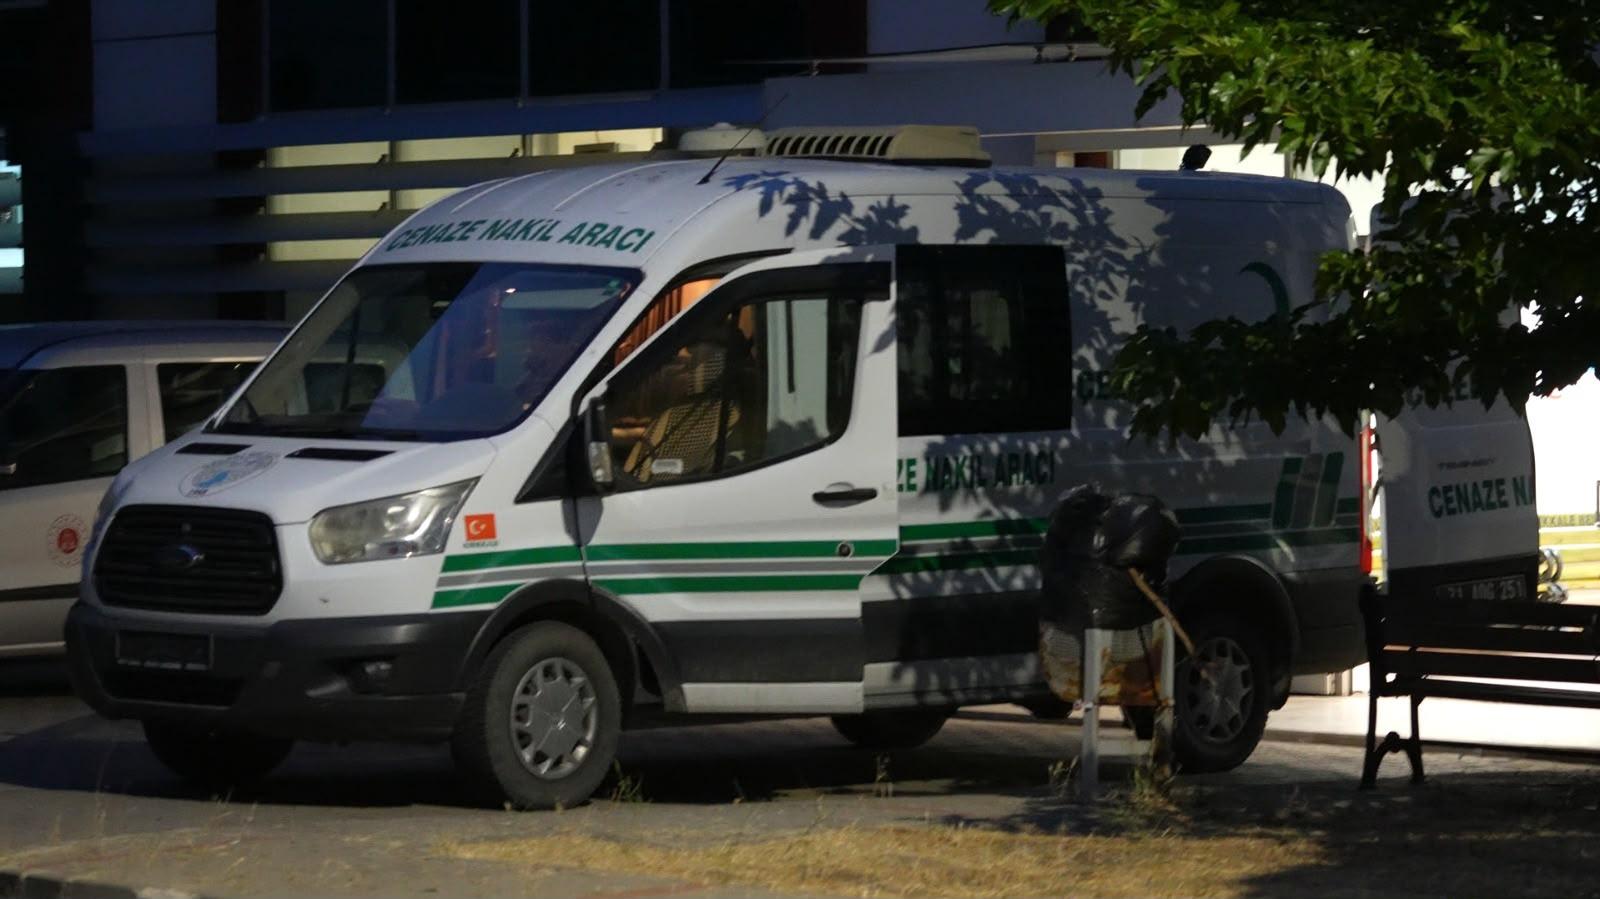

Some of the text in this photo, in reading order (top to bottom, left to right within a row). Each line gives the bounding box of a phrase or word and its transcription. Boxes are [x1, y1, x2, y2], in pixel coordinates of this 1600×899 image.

[386, 219, 488, 251] CENAZE
[557, 222, 655, 253] ARACI
[1428, 478, 1509, 519] CENAZE
